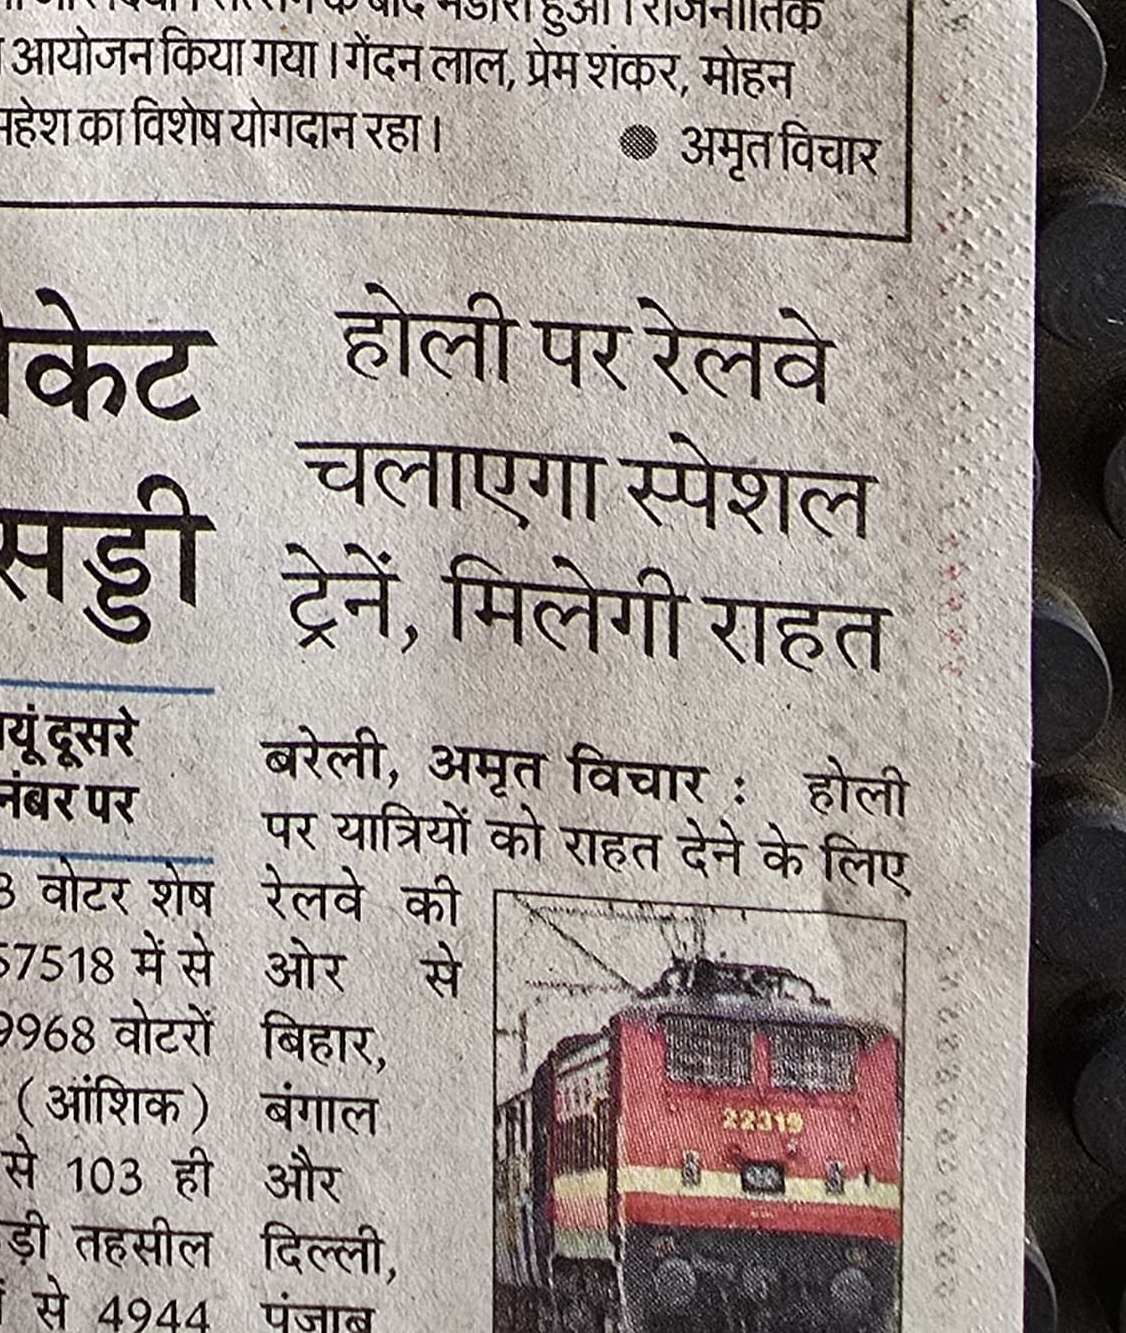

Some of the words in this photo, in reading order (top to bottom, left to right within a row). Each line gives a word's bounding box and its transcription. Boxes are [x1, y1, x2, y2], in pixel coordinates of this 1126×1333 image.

[77, 109, 125, 146] का
[130, 96, 224, 146] विशेष
[228, 97, 357, 149] योगदान
[681, 126, 774, 182] अमृत
[778, 120, 882, 176] विचार
[334, 282, 520, 384] होली
[530, 320, 633, 391] पर
[637, 296, 837, 405] रेलवे
[294, 441, 608, 530] चलाएगा
[617, 431, 879, 540] स्पेशल
[280, 542, 418, 654] ट्रेनें,
[440, 553, 691, 660] मिलेगी
[701, 596, 894, 673] राहत
[45, 705, 140, 767] दूसरे
[259, 725, 398, 789] बरेली,
[428, 745, 549, 798] अमृत
[565, 741, 710, 803] विचार
[803, 755, 911, 818] होली
[85, 785, 140, 824] पर
[261, 812, 318, 850] पर
[331, 800, 472, 856] यात्रियों
[485, 803, 546, 862] को
[559, 826, 663, 872] राहत
[676, 817, 745, 878] देने
[757, 822, 809, 879] के
[819, 832, 911, 897] लिए
[38, 856, 131, 916] वोटर
[150, 864, 214, 919] शेष
[260, 863, 366, 922] रेलवे
[400, 874, 462, 927] की
[265, 936, 348, 992] ओर
[419, 941, 462, 998] से
[260, 1009, 386, 1074] बिहार,
[259, 1081, 379, 1136] बंगाल
[264, 1145, 343, 1203] और
[260, 1220, 396, 1285] दिल्ली,
